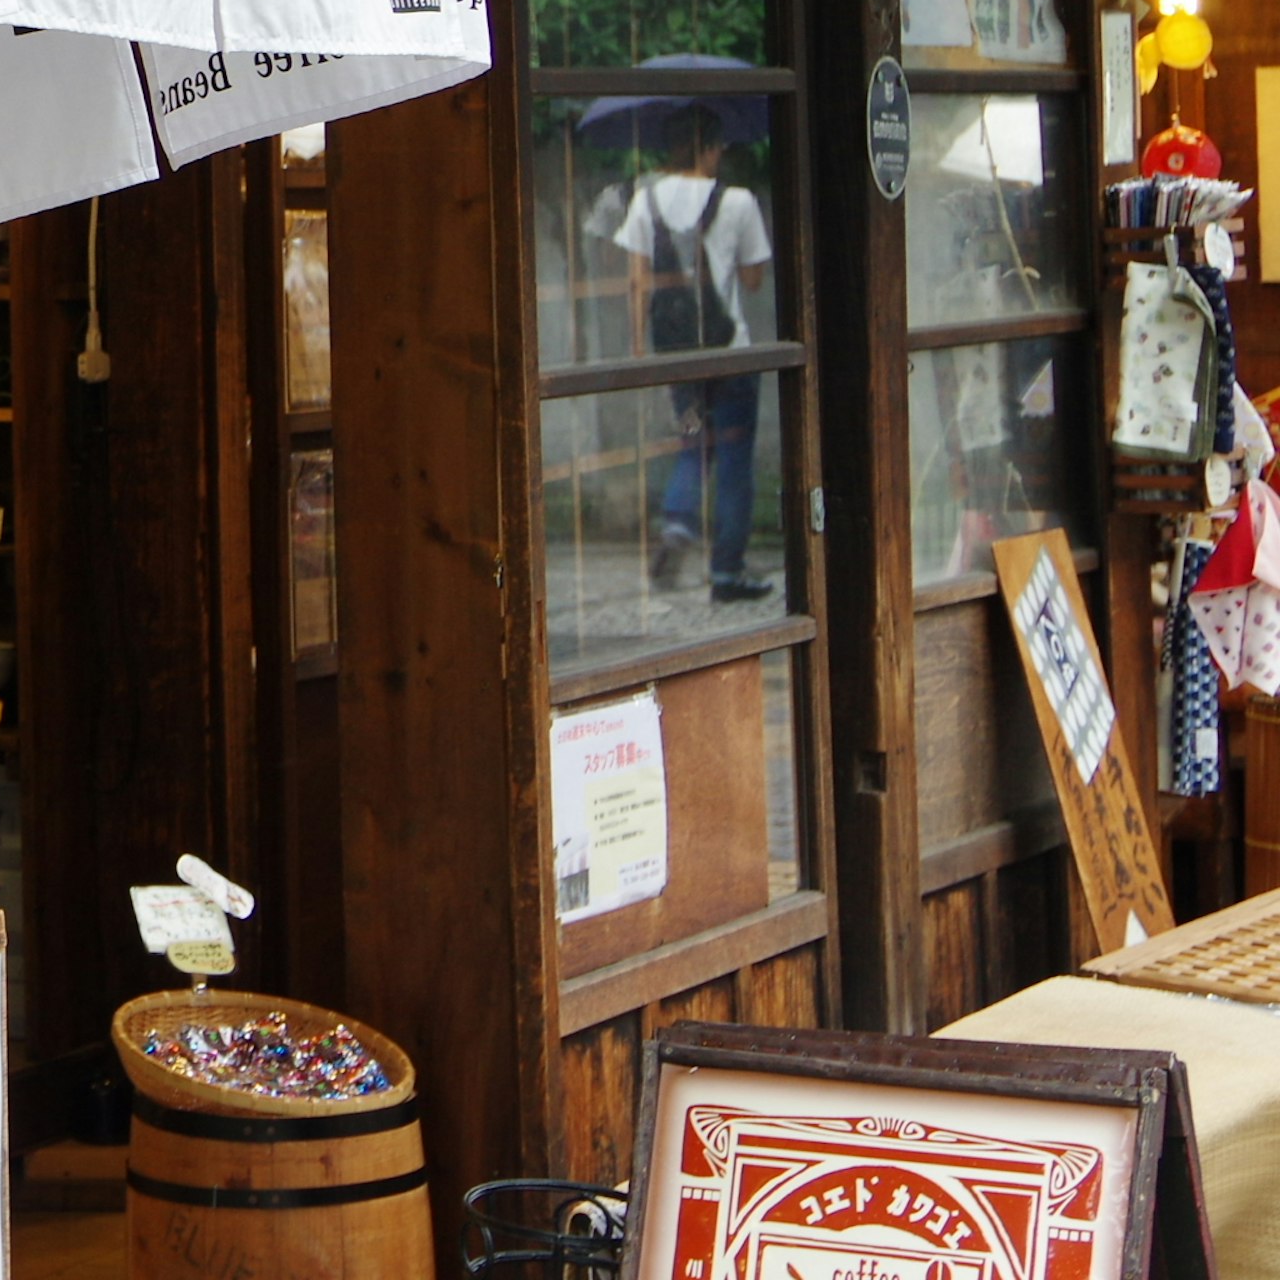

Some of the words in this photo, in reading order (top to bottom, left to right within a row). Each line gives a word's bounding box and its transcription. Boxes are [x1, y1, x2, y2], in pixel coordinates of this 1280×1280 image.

[799, 1176, 880, 1225] コエド
[886, 1184, 972, 1250] カワゴエ
